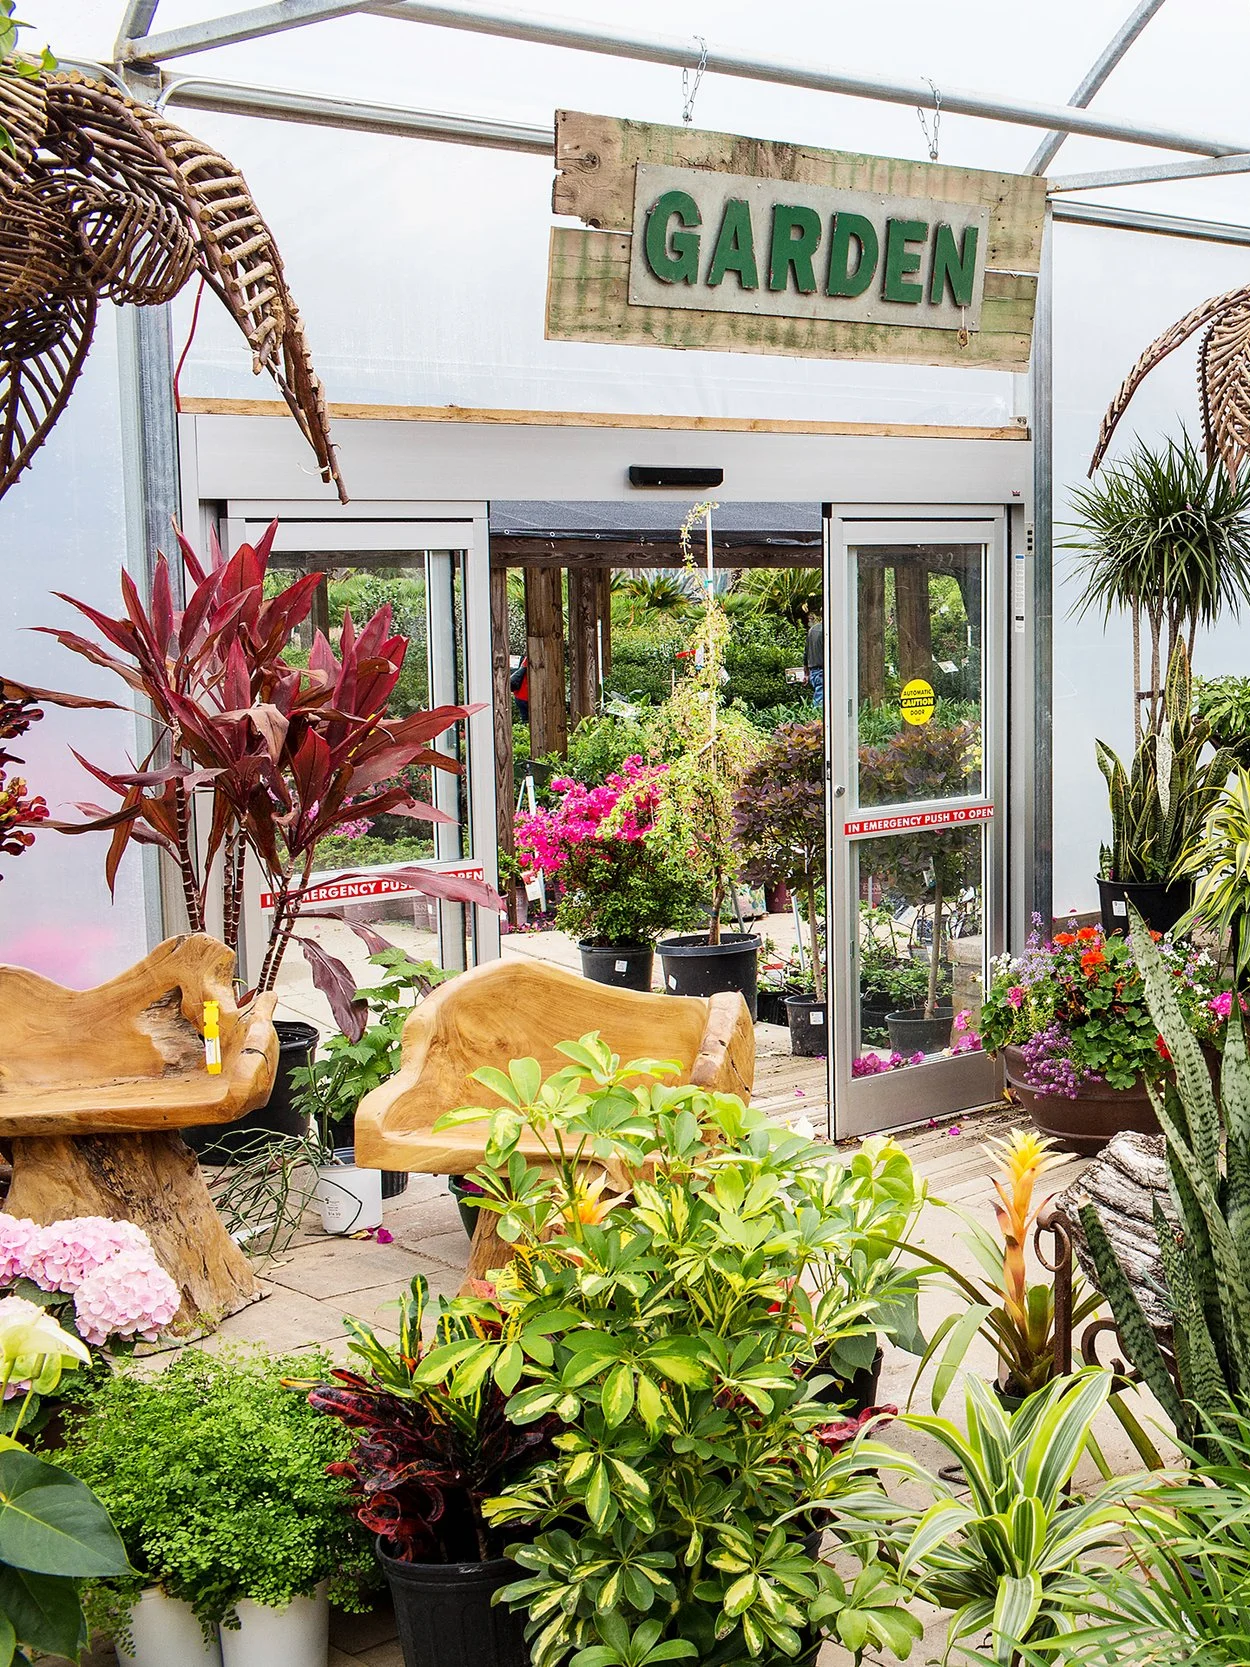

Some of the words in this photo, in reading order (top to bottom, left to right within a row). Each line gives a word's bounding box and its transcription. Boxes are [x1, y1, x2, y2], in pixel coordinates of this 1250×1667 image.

[645, 190, 979, 308] GARDEN
[903, 688, 932, 697] AUTOMATIC
[901, 697, 934, 707] CAUTION
[910, 708, 925, 716] DOOR
[847, 823, 861, 834] IN
[863, 815, 922, 831] EMERGENCY
[924, 812, 950, 825] PUSH
[952, 810, 966, 821] TO
[968, 807, 994, 819] OPEN
[381, 880, 413, 892] PUS
